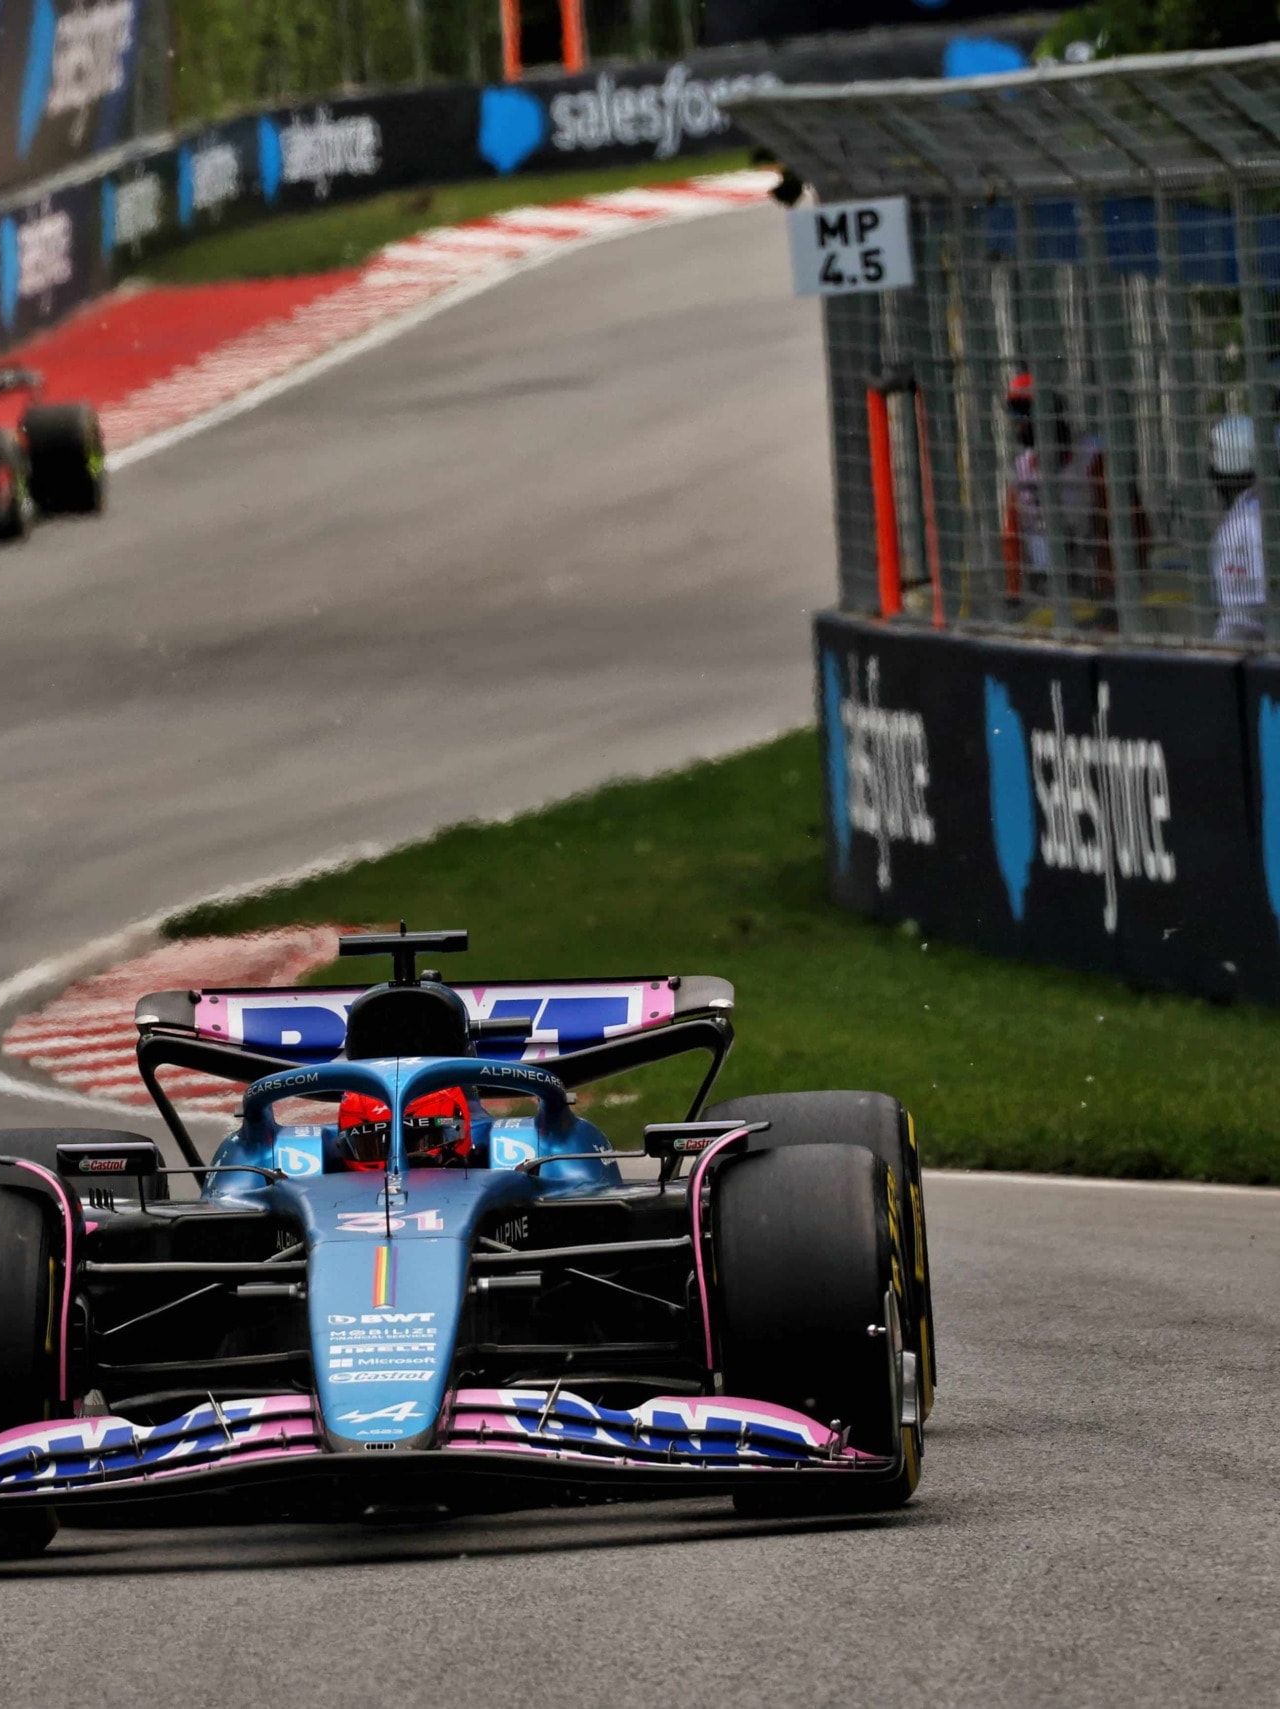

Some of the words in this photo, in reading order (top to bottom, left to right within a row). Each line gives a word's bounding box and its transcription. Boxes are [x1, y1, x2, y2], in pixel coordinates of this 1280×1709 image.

[816, 208, 880, 248] MP
[820, 248, 884, 284] 4.5
[350, 1117, 430, 1137] ALPNE
[90, 1160, 124, 1170] Castrol
[335, 1209, 444, 1233] 31
[361, 1312, 436, 1324] BWT
[329, 1342, 437, 1355] PIRELLI
[358, 1356, 437, 1366] Microsoft
